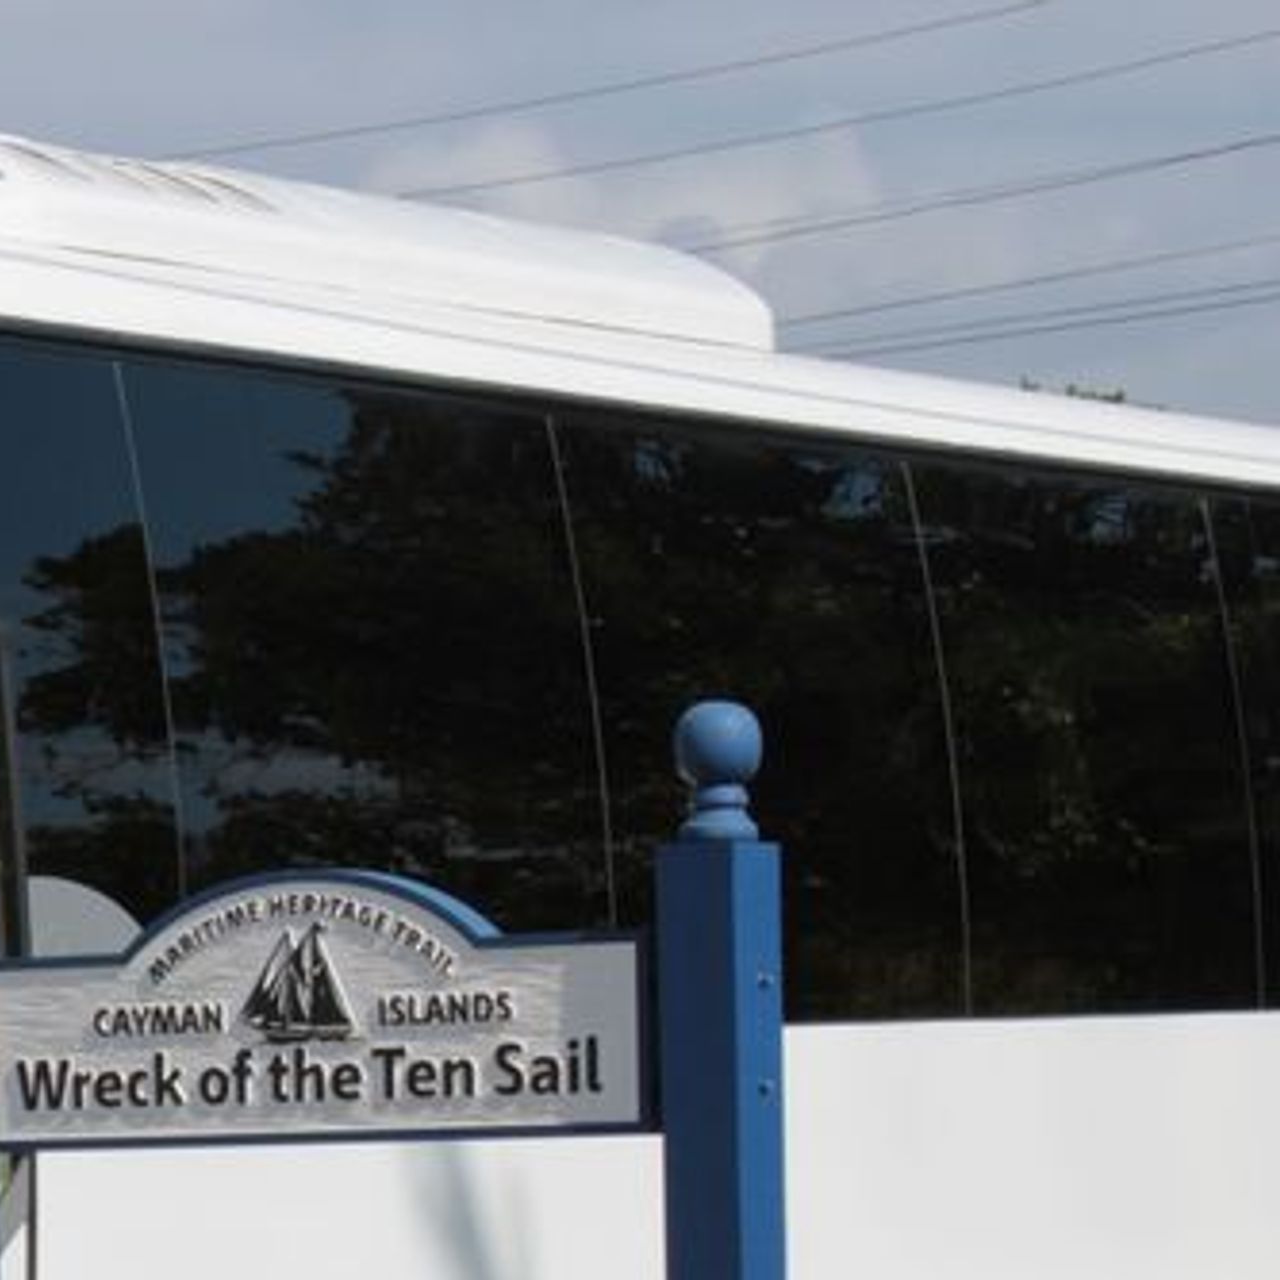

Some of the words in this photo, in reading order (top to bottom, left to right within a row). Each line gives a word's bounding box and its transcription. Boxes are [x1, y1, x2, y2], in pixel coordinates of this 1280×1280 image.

[149, 901, 261, 985] MARITIME
[269, 895, 386, 932] HERITAGE
[393, 920, 456, 977] TRAIL
[93, 1005, 223, 1037] CAYMAN
[377, 992, 513, 1027] ISLANDS
[16, 1053, 184, 1111] Wreck
[200, 1049, 252, 1105] of
[268, 1049, 362, 1101] the
[372, 1047, 475, 1099] Ten
[494, 1036, 602, 1095] Sail
